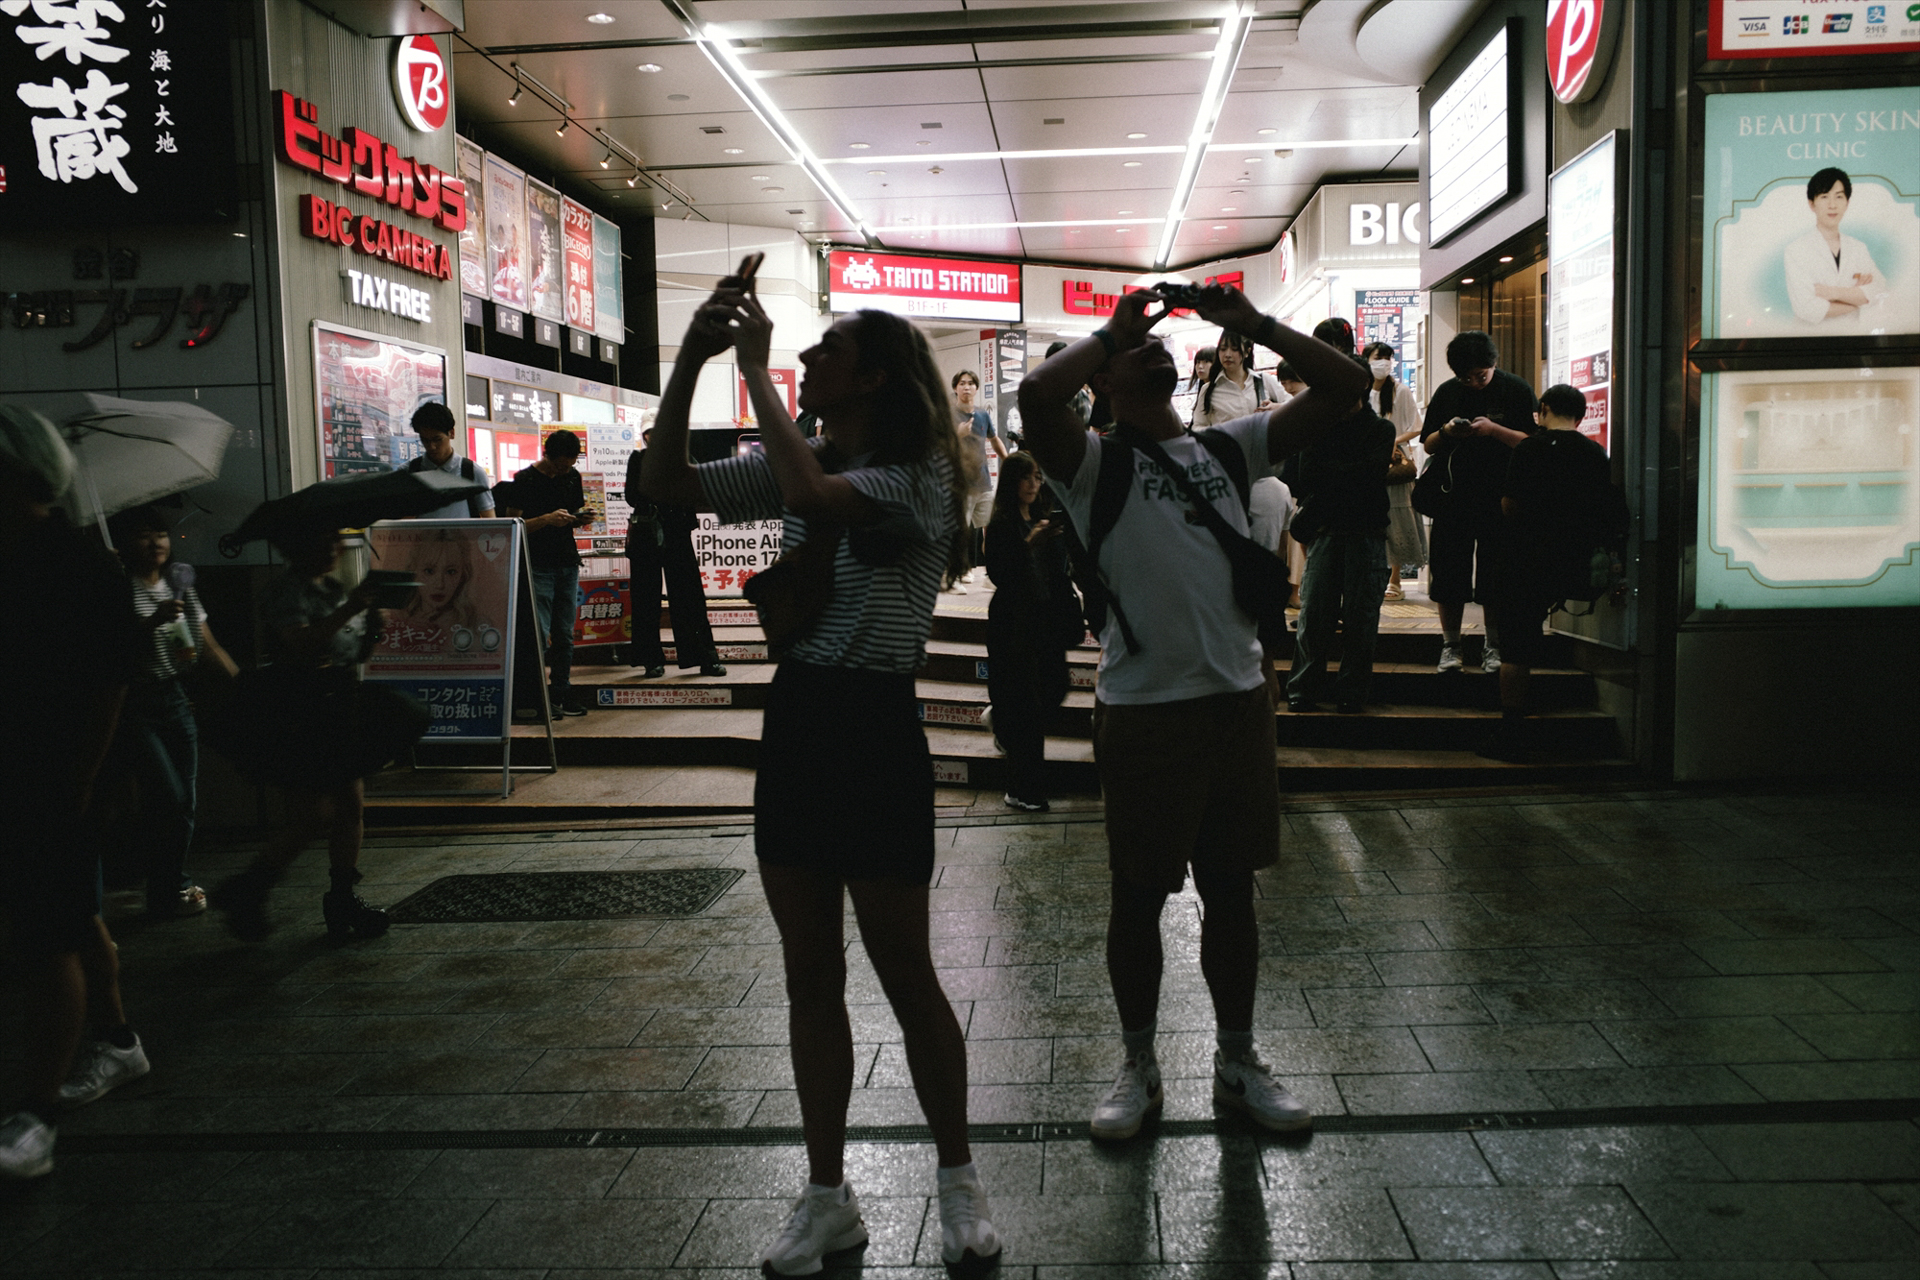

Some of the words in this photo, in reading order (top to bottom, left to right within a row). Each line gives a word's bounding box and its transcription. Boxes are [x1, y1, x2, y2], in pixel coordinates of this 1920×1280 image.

[146, 0, 167, 34] り
[1743, 22, 1767, 32] VISA
[1783, 18, 1809, 32] JCB
[150, 49, 178, 153] 海と大地
[1739, 113, 1847, 137] BEAUTY
[1855, 109, 1920, 132] SKIN
[274, 88, 467, 233] ビックカメラ
[1786, 141, 1867, 160] CLINIC
[563, 203, 592, 232] カラオケ
[308, 194, 356, 248] BIC
[358, 214, 454, 281] CAMERA
[570, 260, 588, 286] 受付
[882, 266, 934, 290] TAITO
[938, 269, 1009, 295] STATION
[348, 269, 389, 311] TAX
[389, 282, 432, 323] FREE
[568, 284, 593, 327] 6階
[908, 300, 949, 314] B1F-1F
[493, 393, 505, 412] 6F
[1143, 476, 1232, 503] FAER
[696, 534, 757, 550] iPhone
[697, 551, 757, 566] iPhone
[579, 602, 623, 620] 買替祭
[417, 687, 477, 703] コンタクト
[429, 703, 498, 719] 取り扱い中
